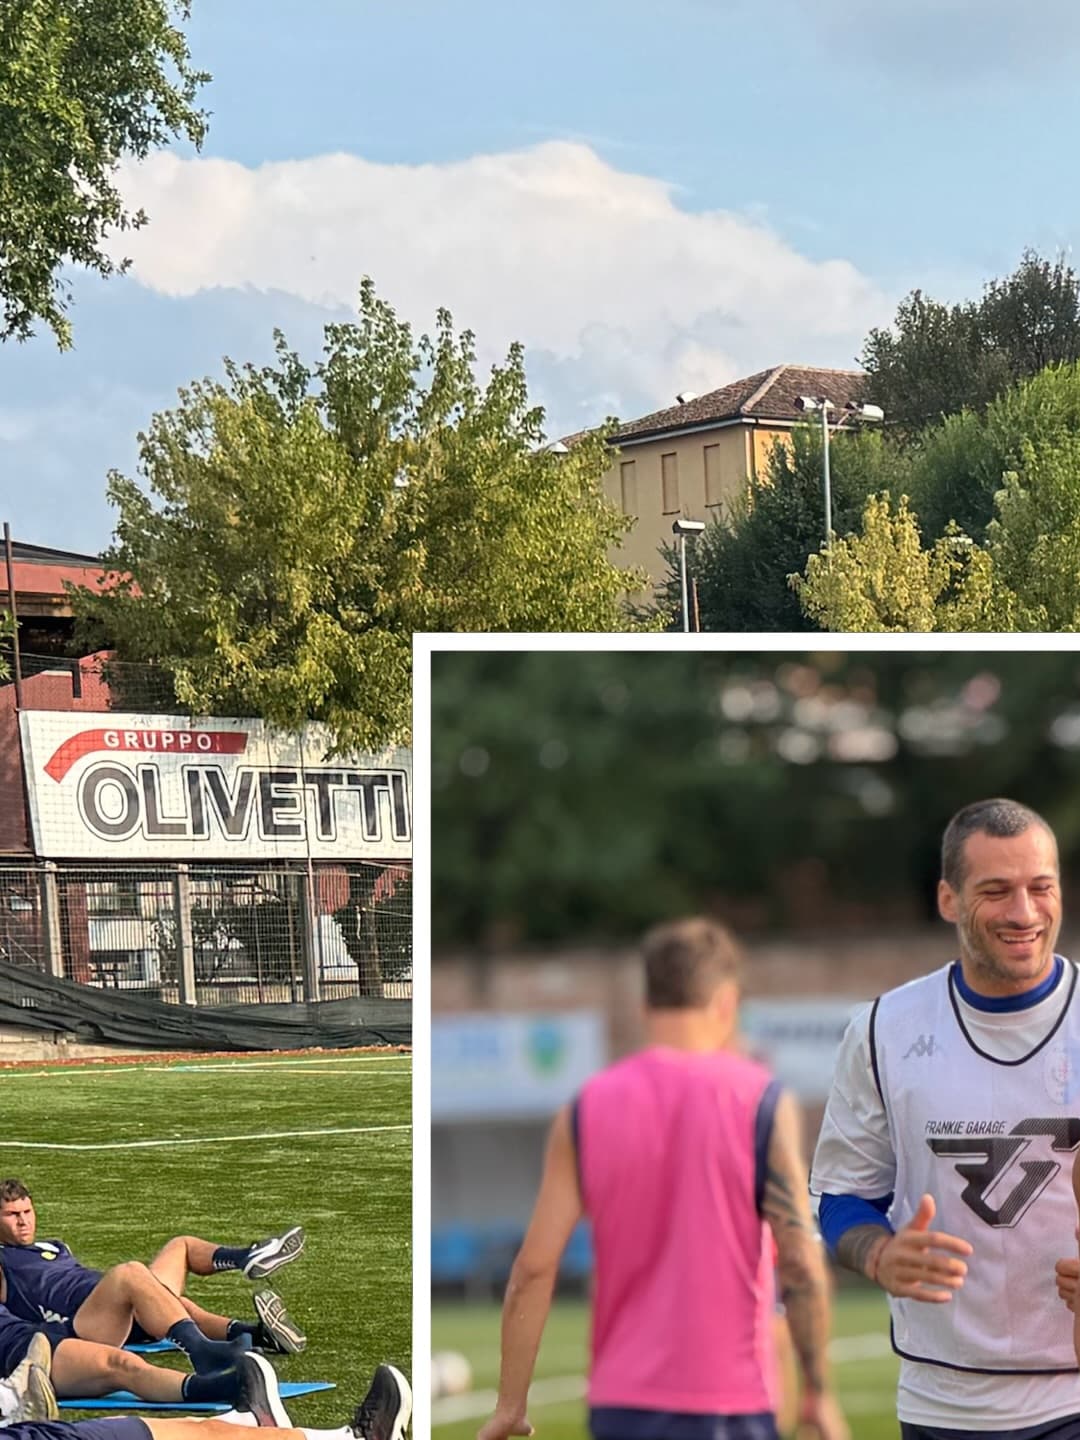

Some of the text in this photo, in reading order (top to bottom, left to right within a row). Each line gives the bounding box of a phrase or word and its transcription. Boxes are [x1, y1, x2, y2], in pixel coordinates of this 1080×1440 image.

[103, 730, 212, 750] GRUPPO
[77, 760, 412, 842] OLIVETTI
[925, 1120, 1007, 1135] FRANKIE GARAGE
